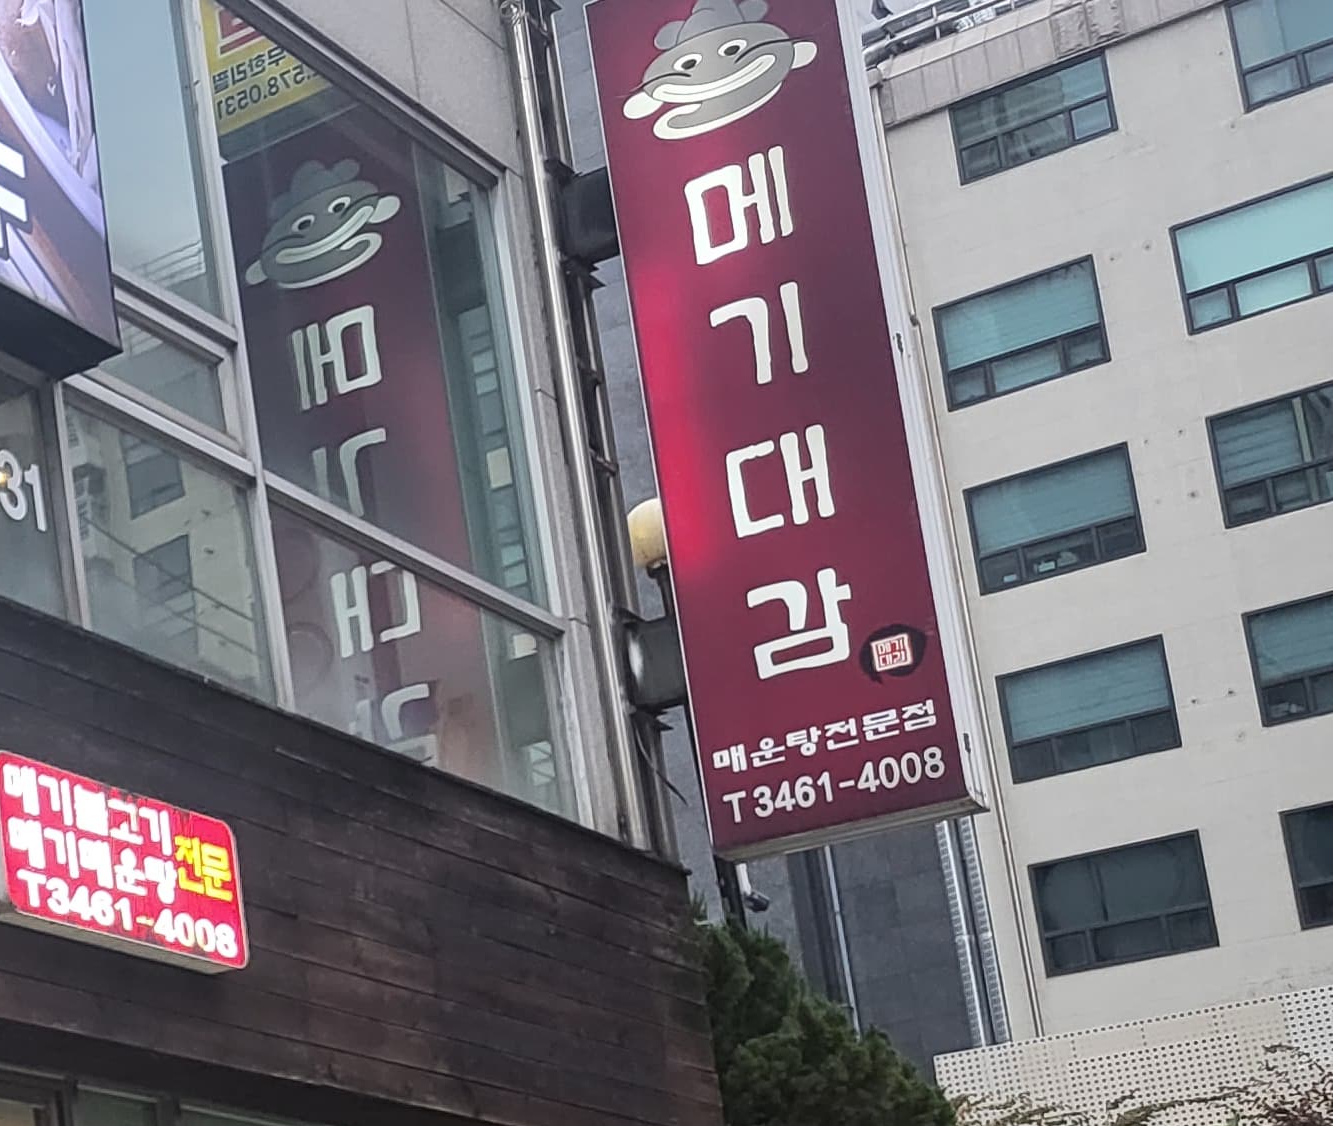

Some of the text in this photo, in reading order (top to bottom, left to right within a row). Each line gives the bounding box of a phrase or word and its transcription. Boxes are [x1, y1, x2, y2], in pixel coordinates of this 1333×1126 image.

[684, 145, 851, 680] 메기대감
[713, 699, 937, 773] 매운탕전문점
[2, 763, 173, 857] 메기불고기
[7, 816, 177, 904] 메기매운탕
[174, 835, 234, 902] 전문
